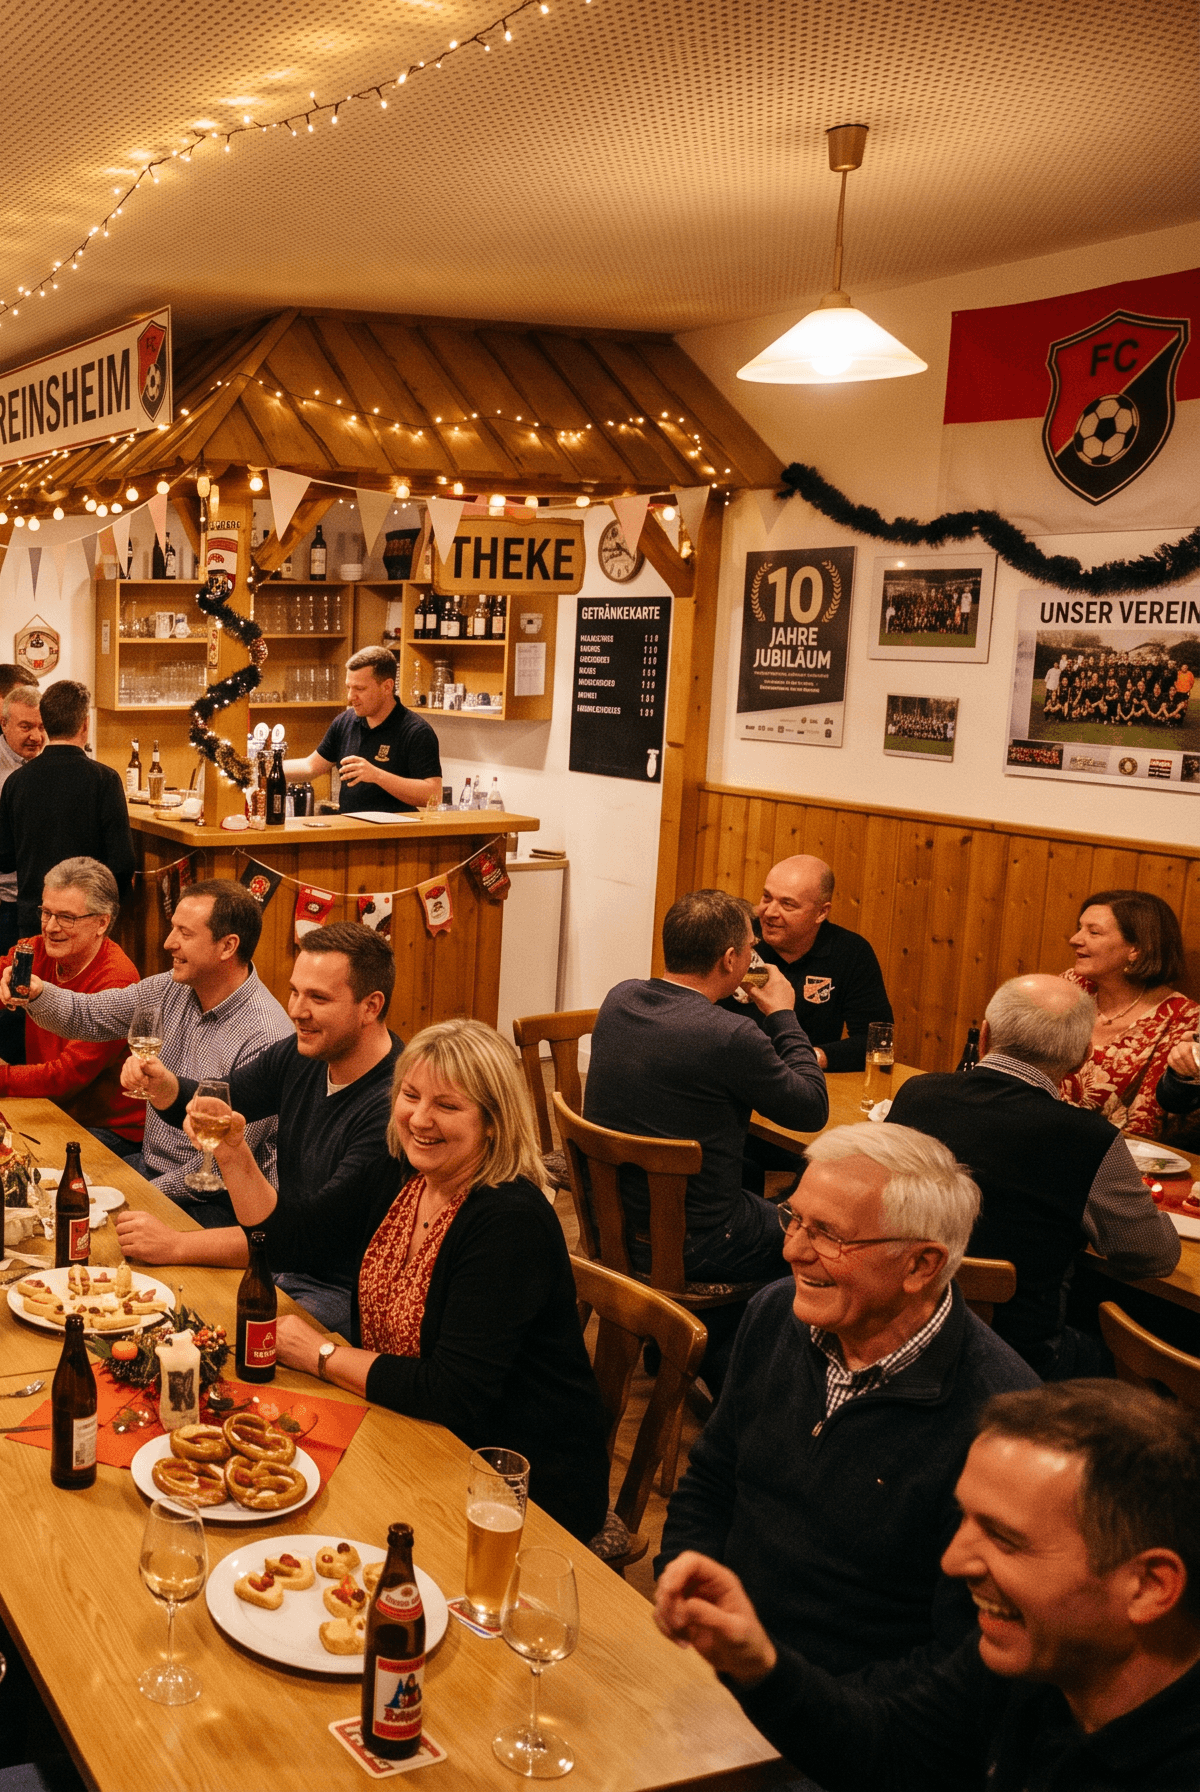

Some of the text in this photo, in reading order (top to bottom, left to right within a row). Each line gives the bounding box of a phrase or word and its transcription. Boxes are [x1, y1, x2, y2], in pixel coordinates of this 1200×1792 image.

[1090, 339, 1139, 377] FC
[452, 536, 575, 581] THEKE
[767, 565, 824, 624] 10
[581, 603, 661, 620] GETRÄNKEKARTE
[1040, 600, 1200, 624] UNSER VEREIN
[769, 627, 819, 647] JAHRE
[753, 647, 831, 669] JUBILÄUM
